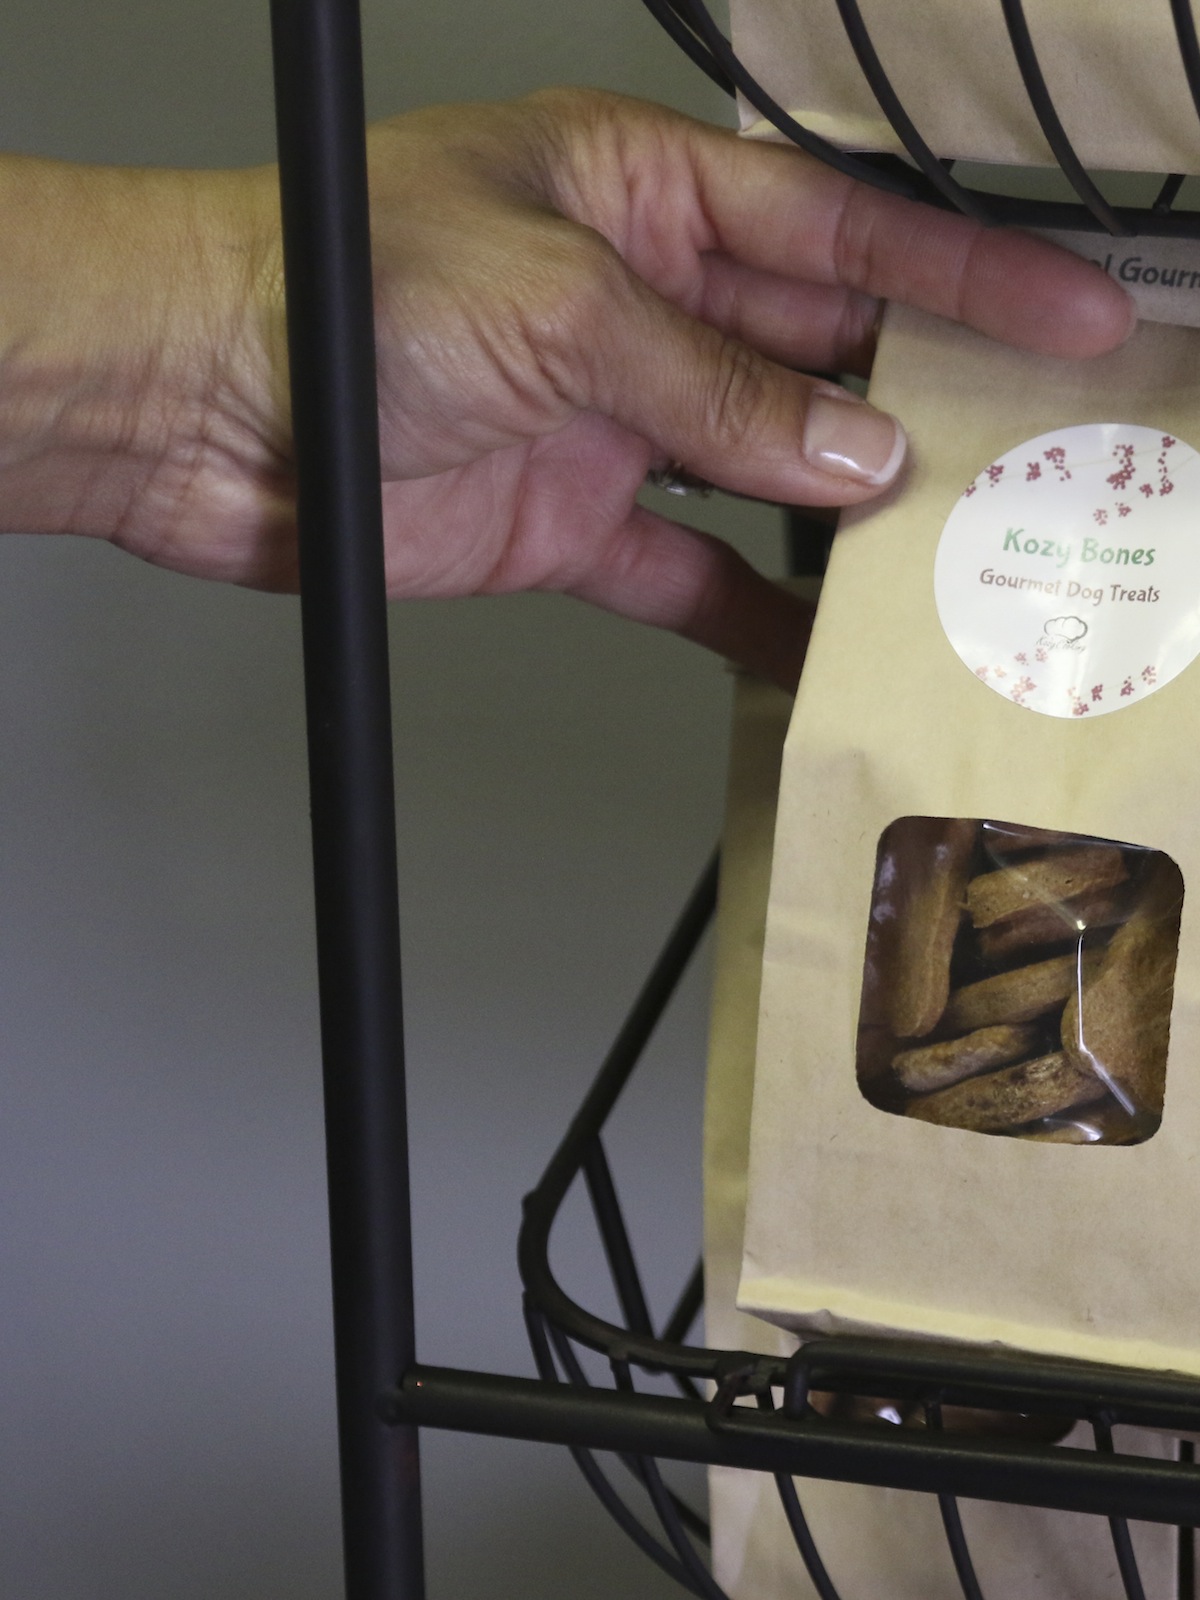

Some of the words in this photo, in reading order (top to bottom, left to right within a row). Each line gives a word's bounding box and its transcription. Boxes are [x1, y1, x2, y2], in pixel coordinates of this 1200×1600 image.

[1002, 527, 1072, 568] Kozy
[1080, 537, 1156, 566] Bones
[979, 568, 1062, 597] Gourmet
[1066, 581, 1104, 606] Dog
[1109, 584, 1161, 604] Treats
